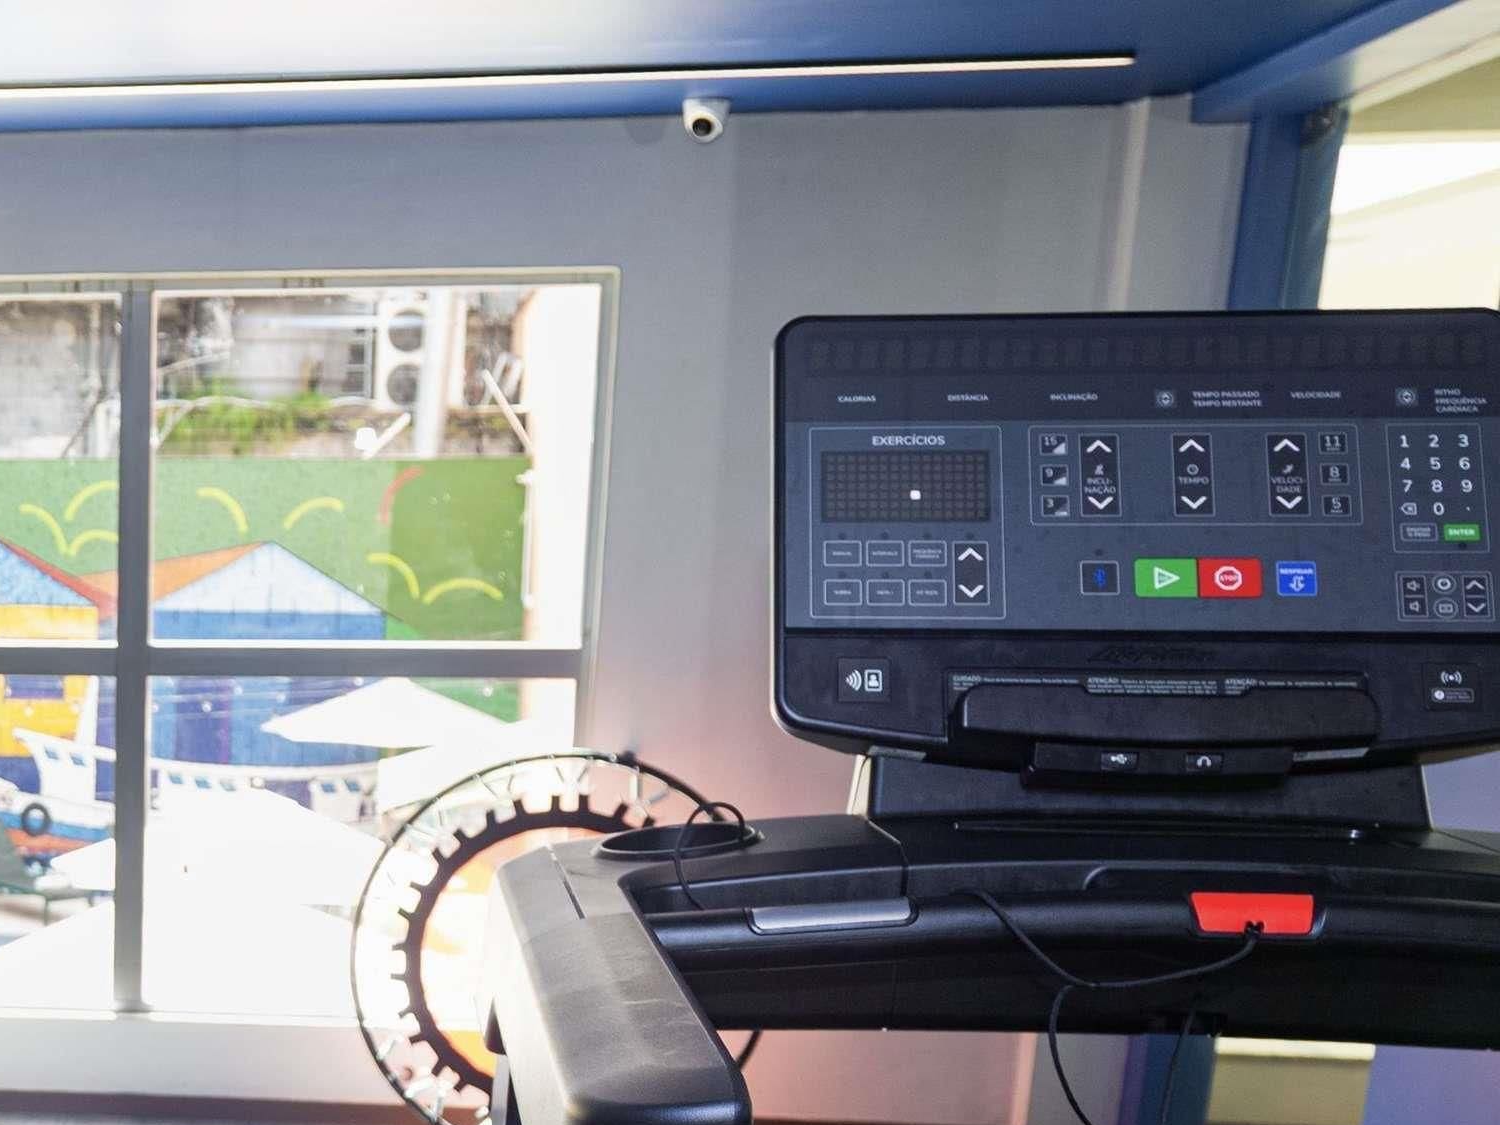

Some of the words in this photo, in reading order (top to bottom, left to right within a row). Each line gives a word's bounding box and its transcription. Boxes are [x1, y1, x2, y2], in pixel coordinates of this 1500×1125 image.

[1049, 393, 1098, 402] INCLINAÇÃO
[1192, 390, 1219, 398] TEMPO
[1221, 390, 1260, 398] PASSADO
[1290, 390, 1341, 399] VELOCIDADE
[1192, 399, 1220, 407] TEMPO
[1221, 399, 1263, 408] RESTANTE
[871, 433, 946, 447] EXERCÍCIOS
[1324, 435, 1342, 448] 11
[1400, 434, 1410, 448] 1
[1428, 434, 1440, 448] 2
[1458, 433, 1469, 448] 3
[1400, 457, 1411, 471] 4
[1429, 457, 1441, 470] 5
[1459, 457, 1470, 471] 6
[1045, 467, 1054, 478] 9
[1329, 466, 1341, 478] 8
[1178, 476, 1210, 485] TEMPO
[1402, 479, 1413, 493] 7
[1431, 479, 1443, 493] 8
[1461, 479, 1473, 493] 9
[1084, 485, 1116, 496] NAÇÃO
[1276, 485, 1302, 493] DADE
[1046, 498, 1054, 508] 3
[1433, 502, 1445, 516] 0
[1447, 528, 1476, 536] ENTER
